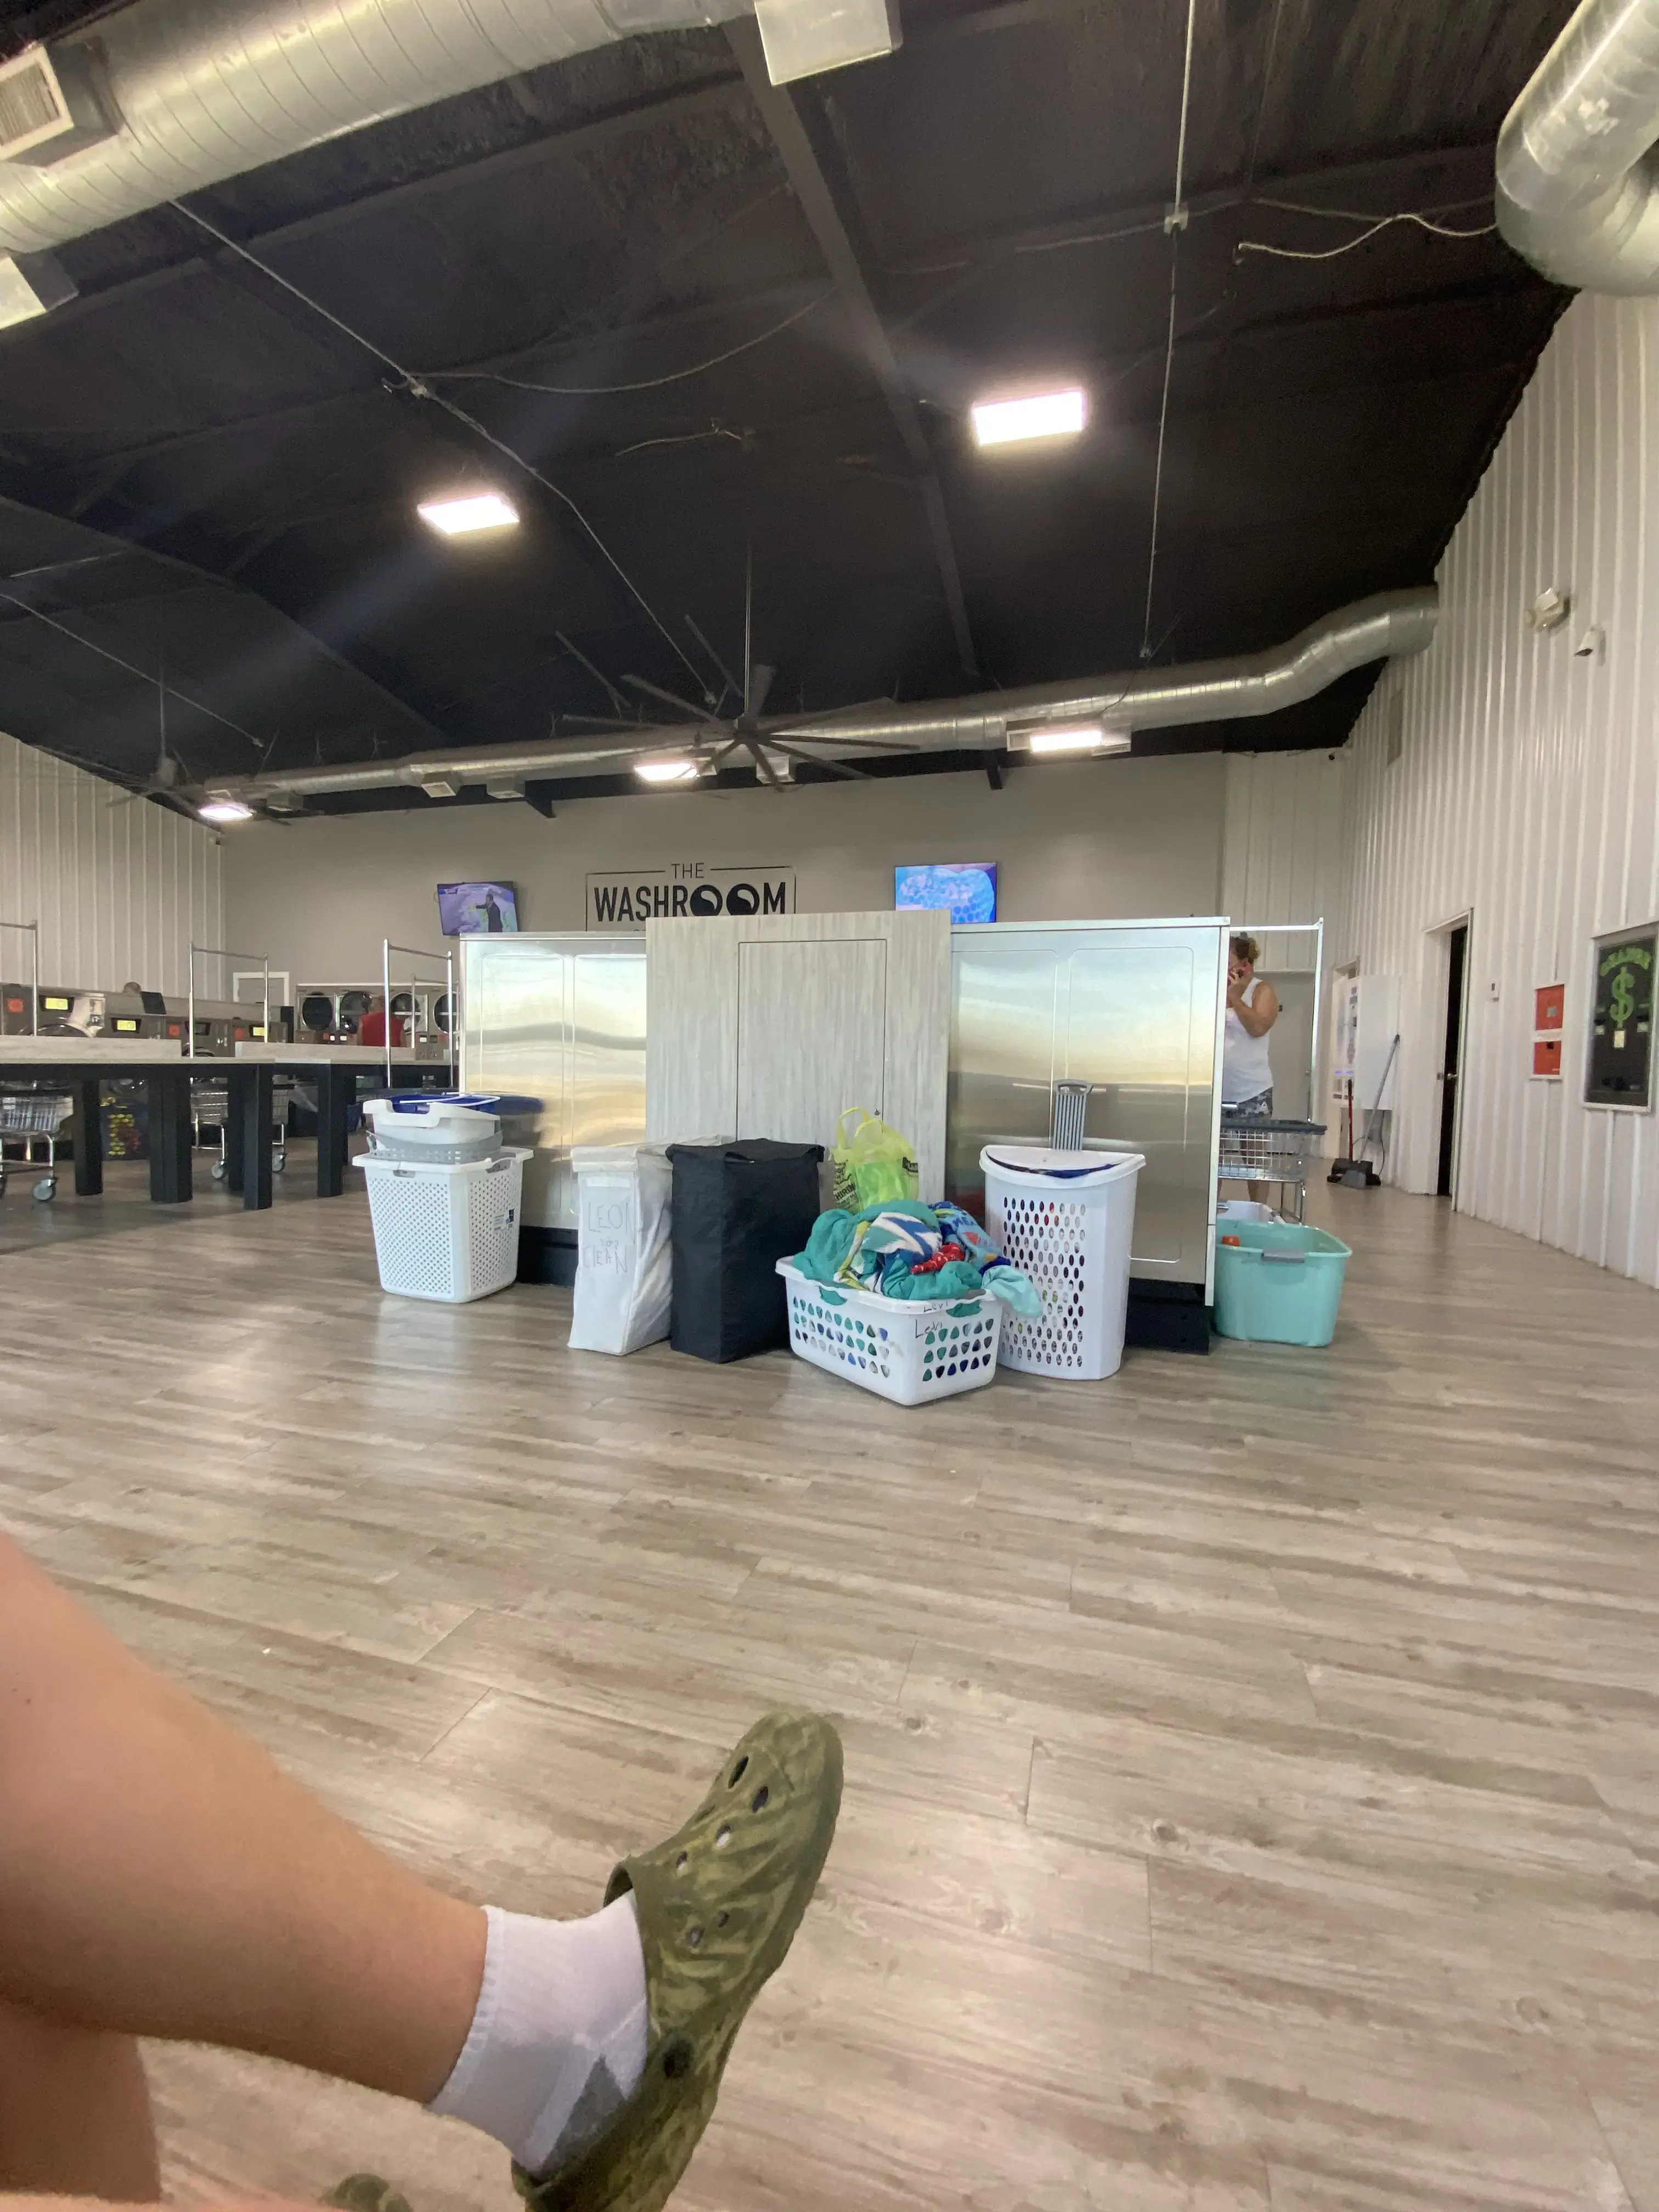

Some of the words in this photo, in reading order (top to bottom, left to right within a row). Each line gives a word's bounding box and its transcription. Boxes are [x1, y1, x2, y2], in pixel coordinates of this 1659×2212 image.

[670, 862, 705, 879] THE
[594, 882, 786, 922] WASHROOM
[834, 1182, 856, 1201] HIRIN
[588, 1201, 636, 1245] LEON
